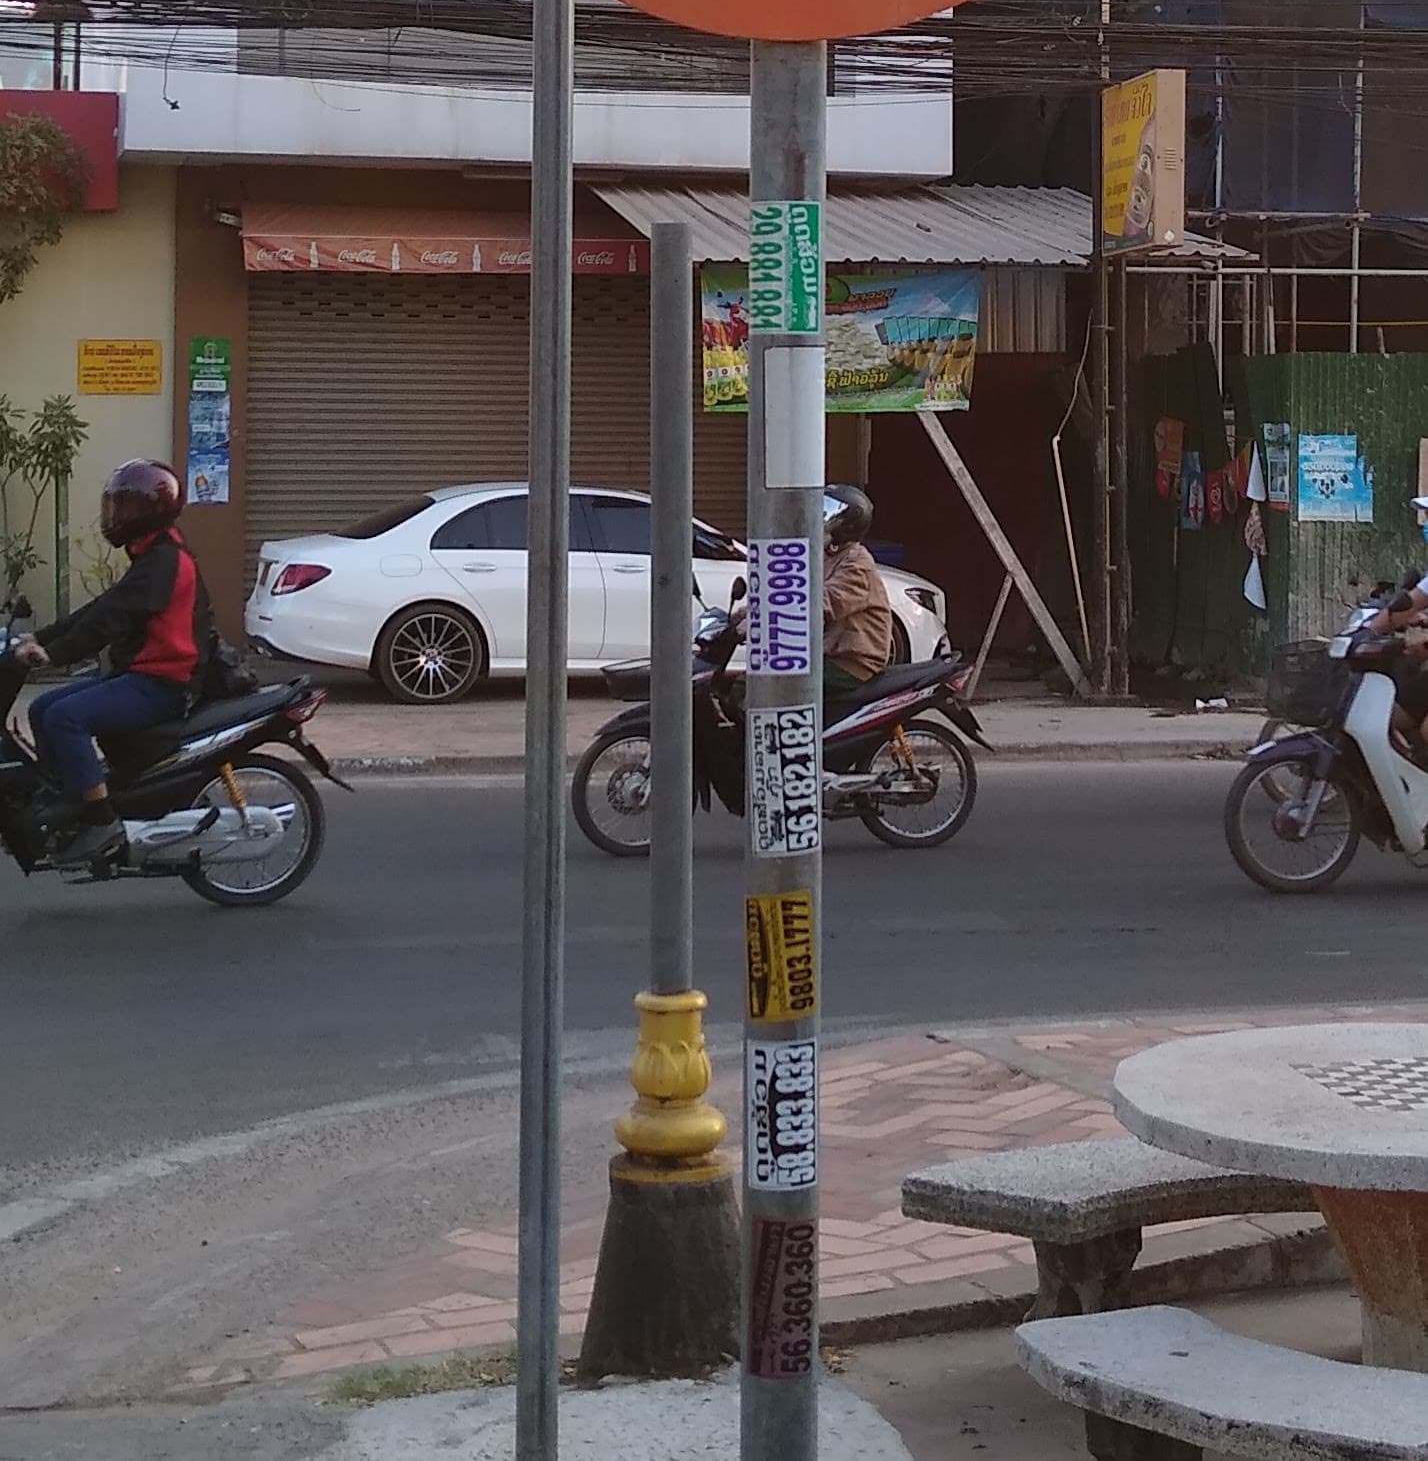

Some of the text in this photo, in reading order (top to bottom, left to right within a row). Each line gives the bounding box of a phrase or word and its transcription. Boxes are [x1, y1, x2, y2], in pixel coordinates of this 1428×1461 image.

[767, 542, 807, 671] 9777.9998
[779, 709, 819, 851] 56.182.182
[781, 900, 815, 1010] 9803.1777
[774, 1044, 816, 1185] 58.833.833
[780, 1223, 815, 1373] 56.360.360
